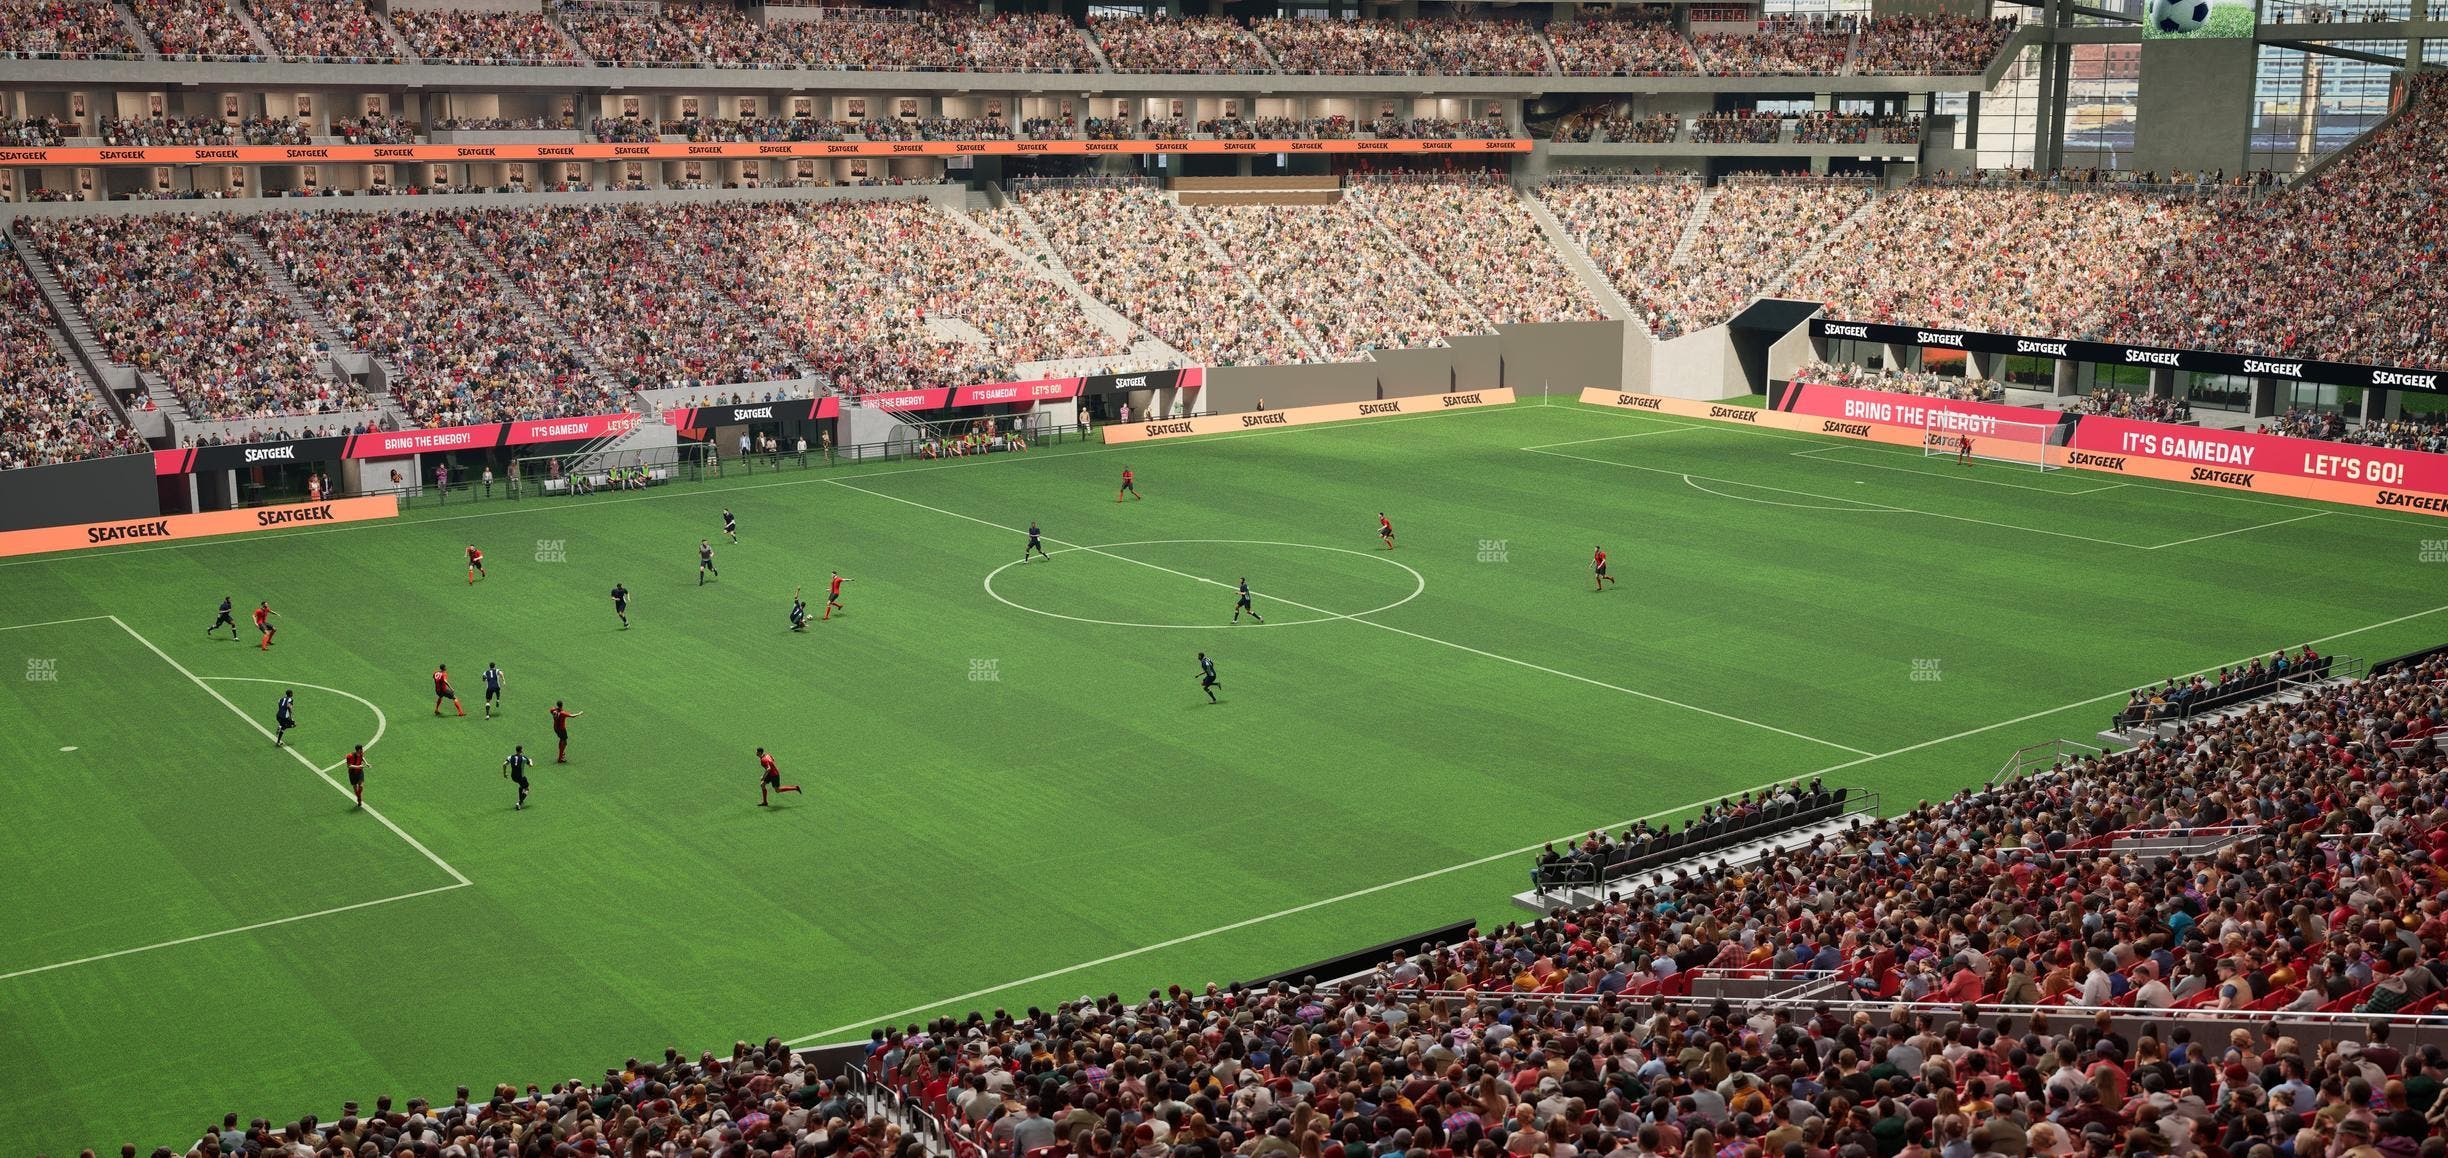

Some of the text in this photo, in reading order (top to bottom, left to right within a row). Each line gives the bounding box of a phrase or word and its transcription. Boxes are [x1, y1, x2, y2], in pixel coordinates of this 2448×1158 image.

[457, 147, 496, 157] SEATGEEK
[537, 147, 575, 156] SEATGEEK
[614, 146, 650, 155] SEATGEEK
[688, 145, 723, 154] SEATGEEK
[759, 145, 792, 154] SEATGEEK
[827, 144, 859, 153] SEATGEEK
[893, 144, 922, 153] SEATGEEK
[956, 144, 986, 152] SEATGEEK
[1017, 143, 1047, 151] SEATGEEK
[1085, 143, 1119, 151] SEATGEEK
[1155, 143, 1188, 151] SEATGEEK
[1291, 142, 1323, 150] SEATGEEK
[1357, 142, 1388, 150] SEATGEEK
[1422, 142, 1453, 150] SEATGEEK
[0, 151, 48, 161] SEATGEEK
[99, 150, 145, 160] SEATGEEK
[195, 149, 239, 159] SEATGEEK
[286, 148, 329, 159] SEATGEEK
[373, 148, 414, 158] SEATGEEK
[1825, 324, 1867, 338] SEATGEEK
[1917, 332, 1963, 346] SEATGEEK
[2017, 340, 2067, 356] SEATGEEK
[2126, 350, 2179, 366] SEATGEEK
[2244, 360, 2302, 377] SEATGEEK
[1116, 376, 1146, 389] SEATGEEK
[2372, 371, 2437, 389] SEATGEEK
[973, 388, 1017, 400] IT'S GAMEDAY
[1032, 384, 1062, 395] LET'S GO!
[895, 396, 925, 407] ENERGY!
[1443, 393, 1482, 406] SEATGEEK
[1618, 395, 1661, 409] SEATGEEK
[734, 406, 772, 421] SEATGEEK
[1359, 401, 1400, 415] SEATGEEK
[1710, 406, 1758, 422] SEATGEEK
[1243, 412, 1286, 427] SEATGEEK
[1845, 399, 1996, 435] BRING THE ENERGY!
[532, 423, 588, 437] IT'S GAMEDAY
[1146, 422, 1193, 436] SEATGEEK
[1823, 421, 1871, 437] SEATGEEK
[385, 433, 470, 449] BRING THE ENERGY!
[245, 445, 294, 462] SEATGEEK
[2123, 432, 2254, 465] IT'S GAMEDAY
[2068, 452, 2126, 470] SEATGEEK
[2304, 453, 2403, 484] LET'S GO!
[2191, 467, 2254, 487] SEATGEEK
[258, 505, 334, 526] SEATGEEK
[88, 521, 170, 543] SEATGEEK
